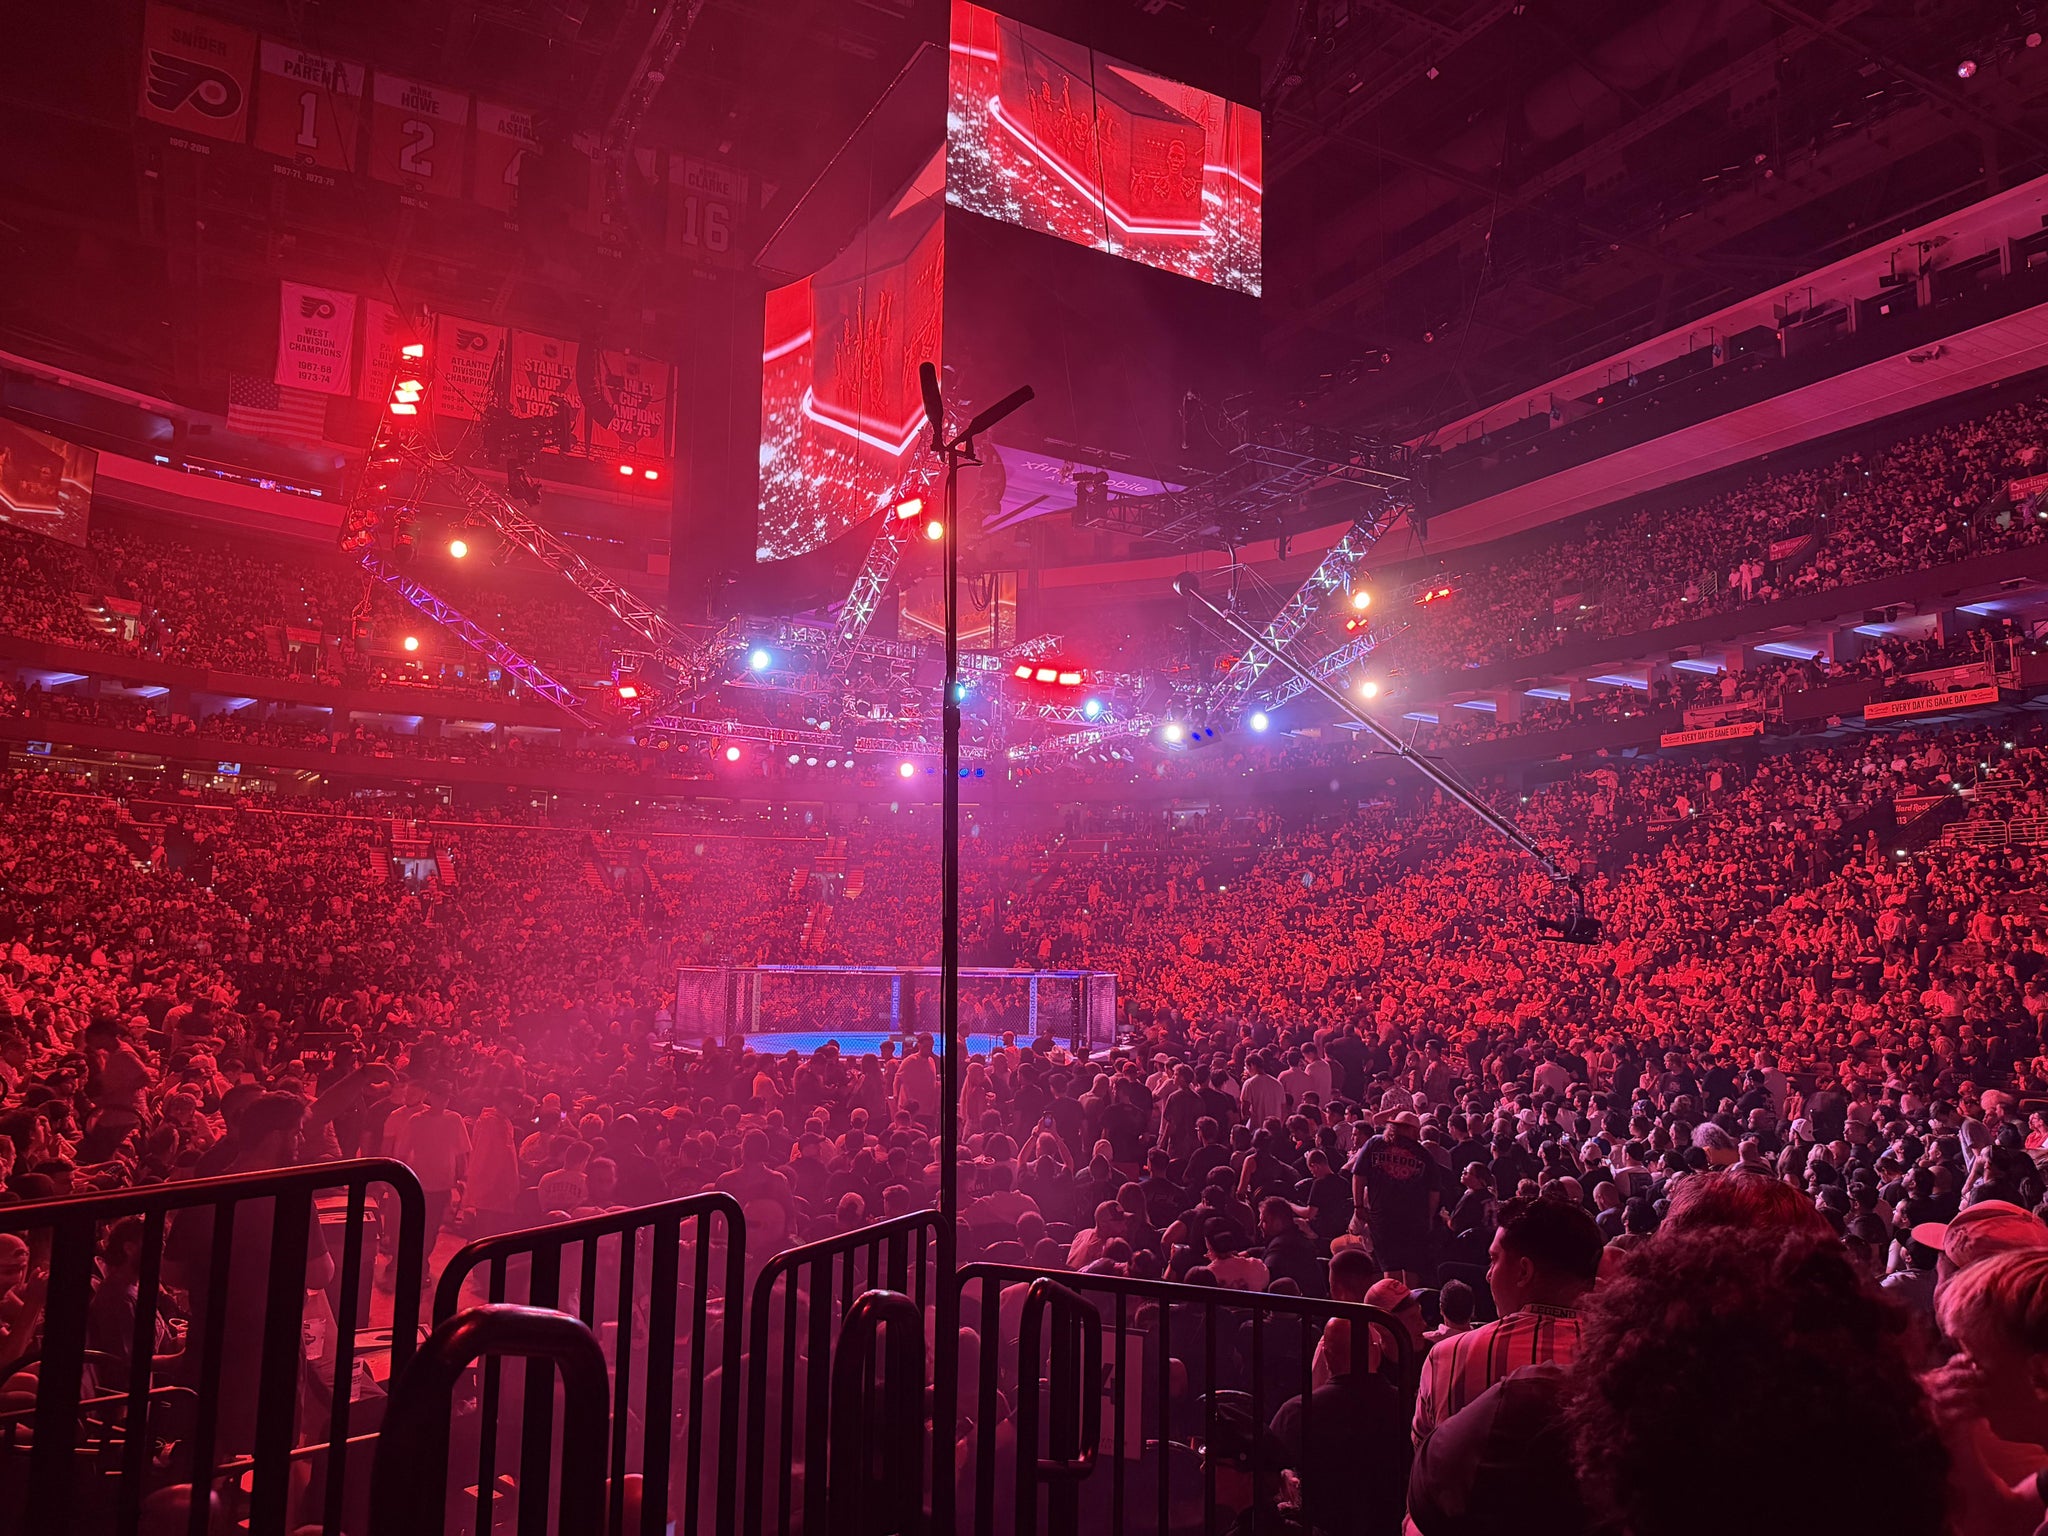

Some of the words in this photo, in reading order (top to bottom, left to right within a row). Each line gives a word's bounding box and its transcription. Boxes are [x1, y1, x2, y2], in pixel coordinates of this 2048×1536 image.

[170, 29, 228, 57] SNIDER
[284, 59, 345, 91] PAREN
[401, 92, 440, 115] HOWE
[297, 91, 319, 149] 1
[400, 118, 435, 178] 2
[688, 172, 731, 196] CLARKE
[681, 196, 731, 254] 16
[297, 335, 336, 349] DIVISION
[304, 327, 330, 339] WEST
[289, 342, 342, 360] CHAMPIONS
[452, 357, 492, 372] ATLANTIC
[453, 365, 489, 380] DIVISION
[524, 358, 577, 381] STANLEY
[298, 371, 331, 384] 1973-74
[537, 374, 562, 391] CUP
[612, 403, 662, 427] AMPIONS
[1892, 701, 1910, 713] EVERY
[1912, 699, 1925, 710] DAY
[1926, 699, 1933, 708] IS
[1934, 697, 1953, 708] GAME
[1954, 694, 1968, 704] DAY
[1681, 731, 1697, 743] EVERY
[1698, 730, 1707, 741] DAY
[1708, 730, 1714, 739] IS
[1714, 728, 1730, 738] GAME
[1730, 727, 1741, 736] DAY
[1896, 804, 1913, 813] Hard
[1896, 816, 1908, 825] 113
[1371, 1151, 1426, 1178] FREEDOM
[1531, 1303, 1577, 1320] LEGEND
